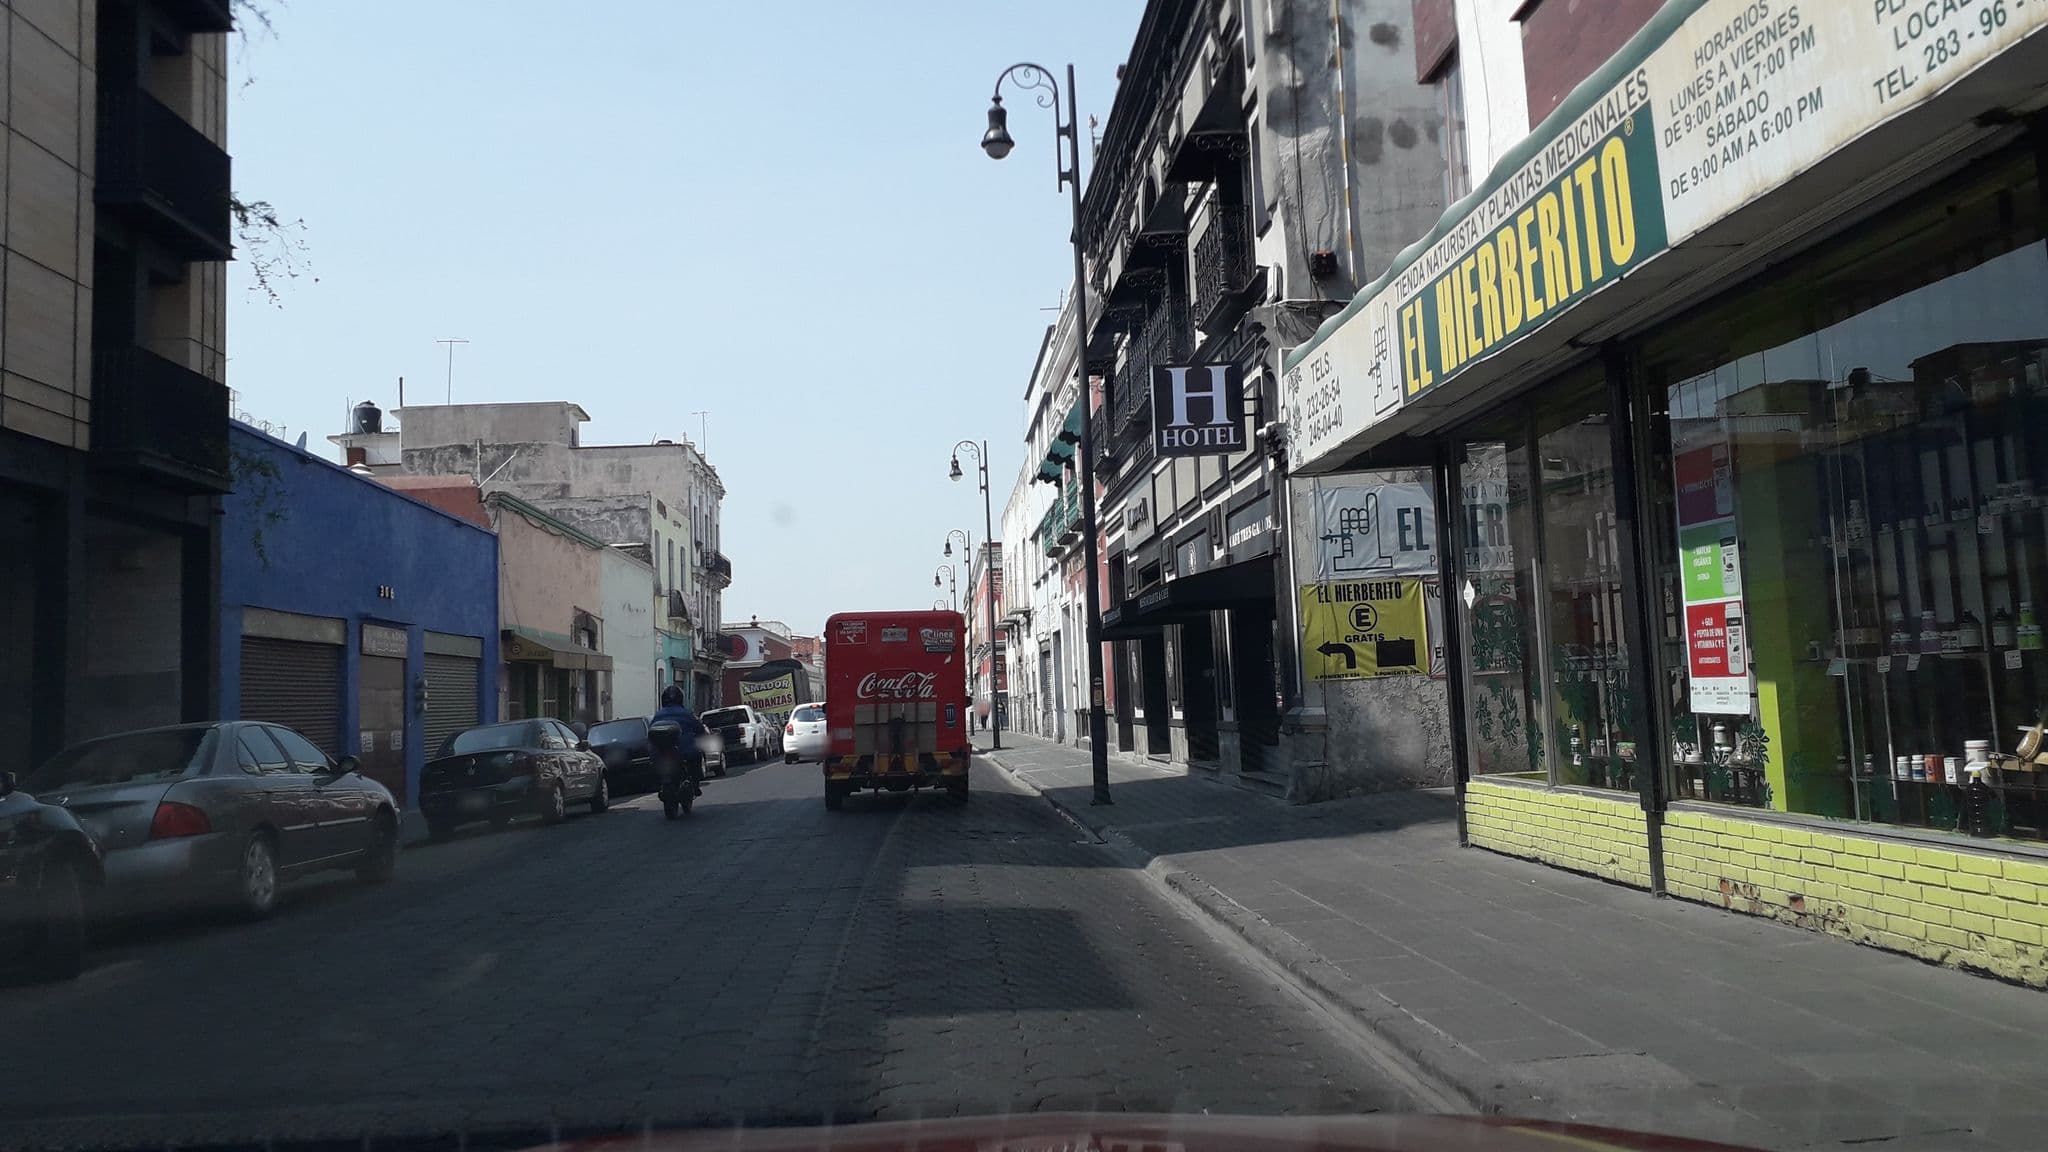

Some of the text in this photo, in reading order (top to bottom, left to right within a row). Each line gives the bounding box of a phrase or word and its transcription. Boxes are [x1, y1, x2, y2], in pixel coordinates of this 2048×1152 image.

[1694, 0, 1769, 70] HORARIOS
[1875, 0, 1907, 24] PL
[1664, 24, 1816, 148] DE 9:00 AM A 7:00 PM
[1670, 5, 1800, 117] LUNES A VIERNES
[1873, 66, 1919, 104] TEL.
[1924, 29, 1960, 73] 283
[1670, 86, 1824, 200] DE 9:00 AM A 6:00 PM
[1706, 90, 1769, 148] SÁBADO
[1395, 68, 1648, 303] TIENDA NATURISTA Y PLANTAS MEDICINALES
[1402, 136, 1636, 397] EL HIERBERITO
[1165, 365, 1235, 427] H
[1311, 351, 1332, 385] TELS.
[1162, 426, 1241, 447] HOTEL
[1397, 506, 1430, 552] EL
[1318, 581, 1402, 604] EL HIERBERITO
[1344, 632, 1385, 643] GRATIS
[744, 680, 789, 695] AMADOR
